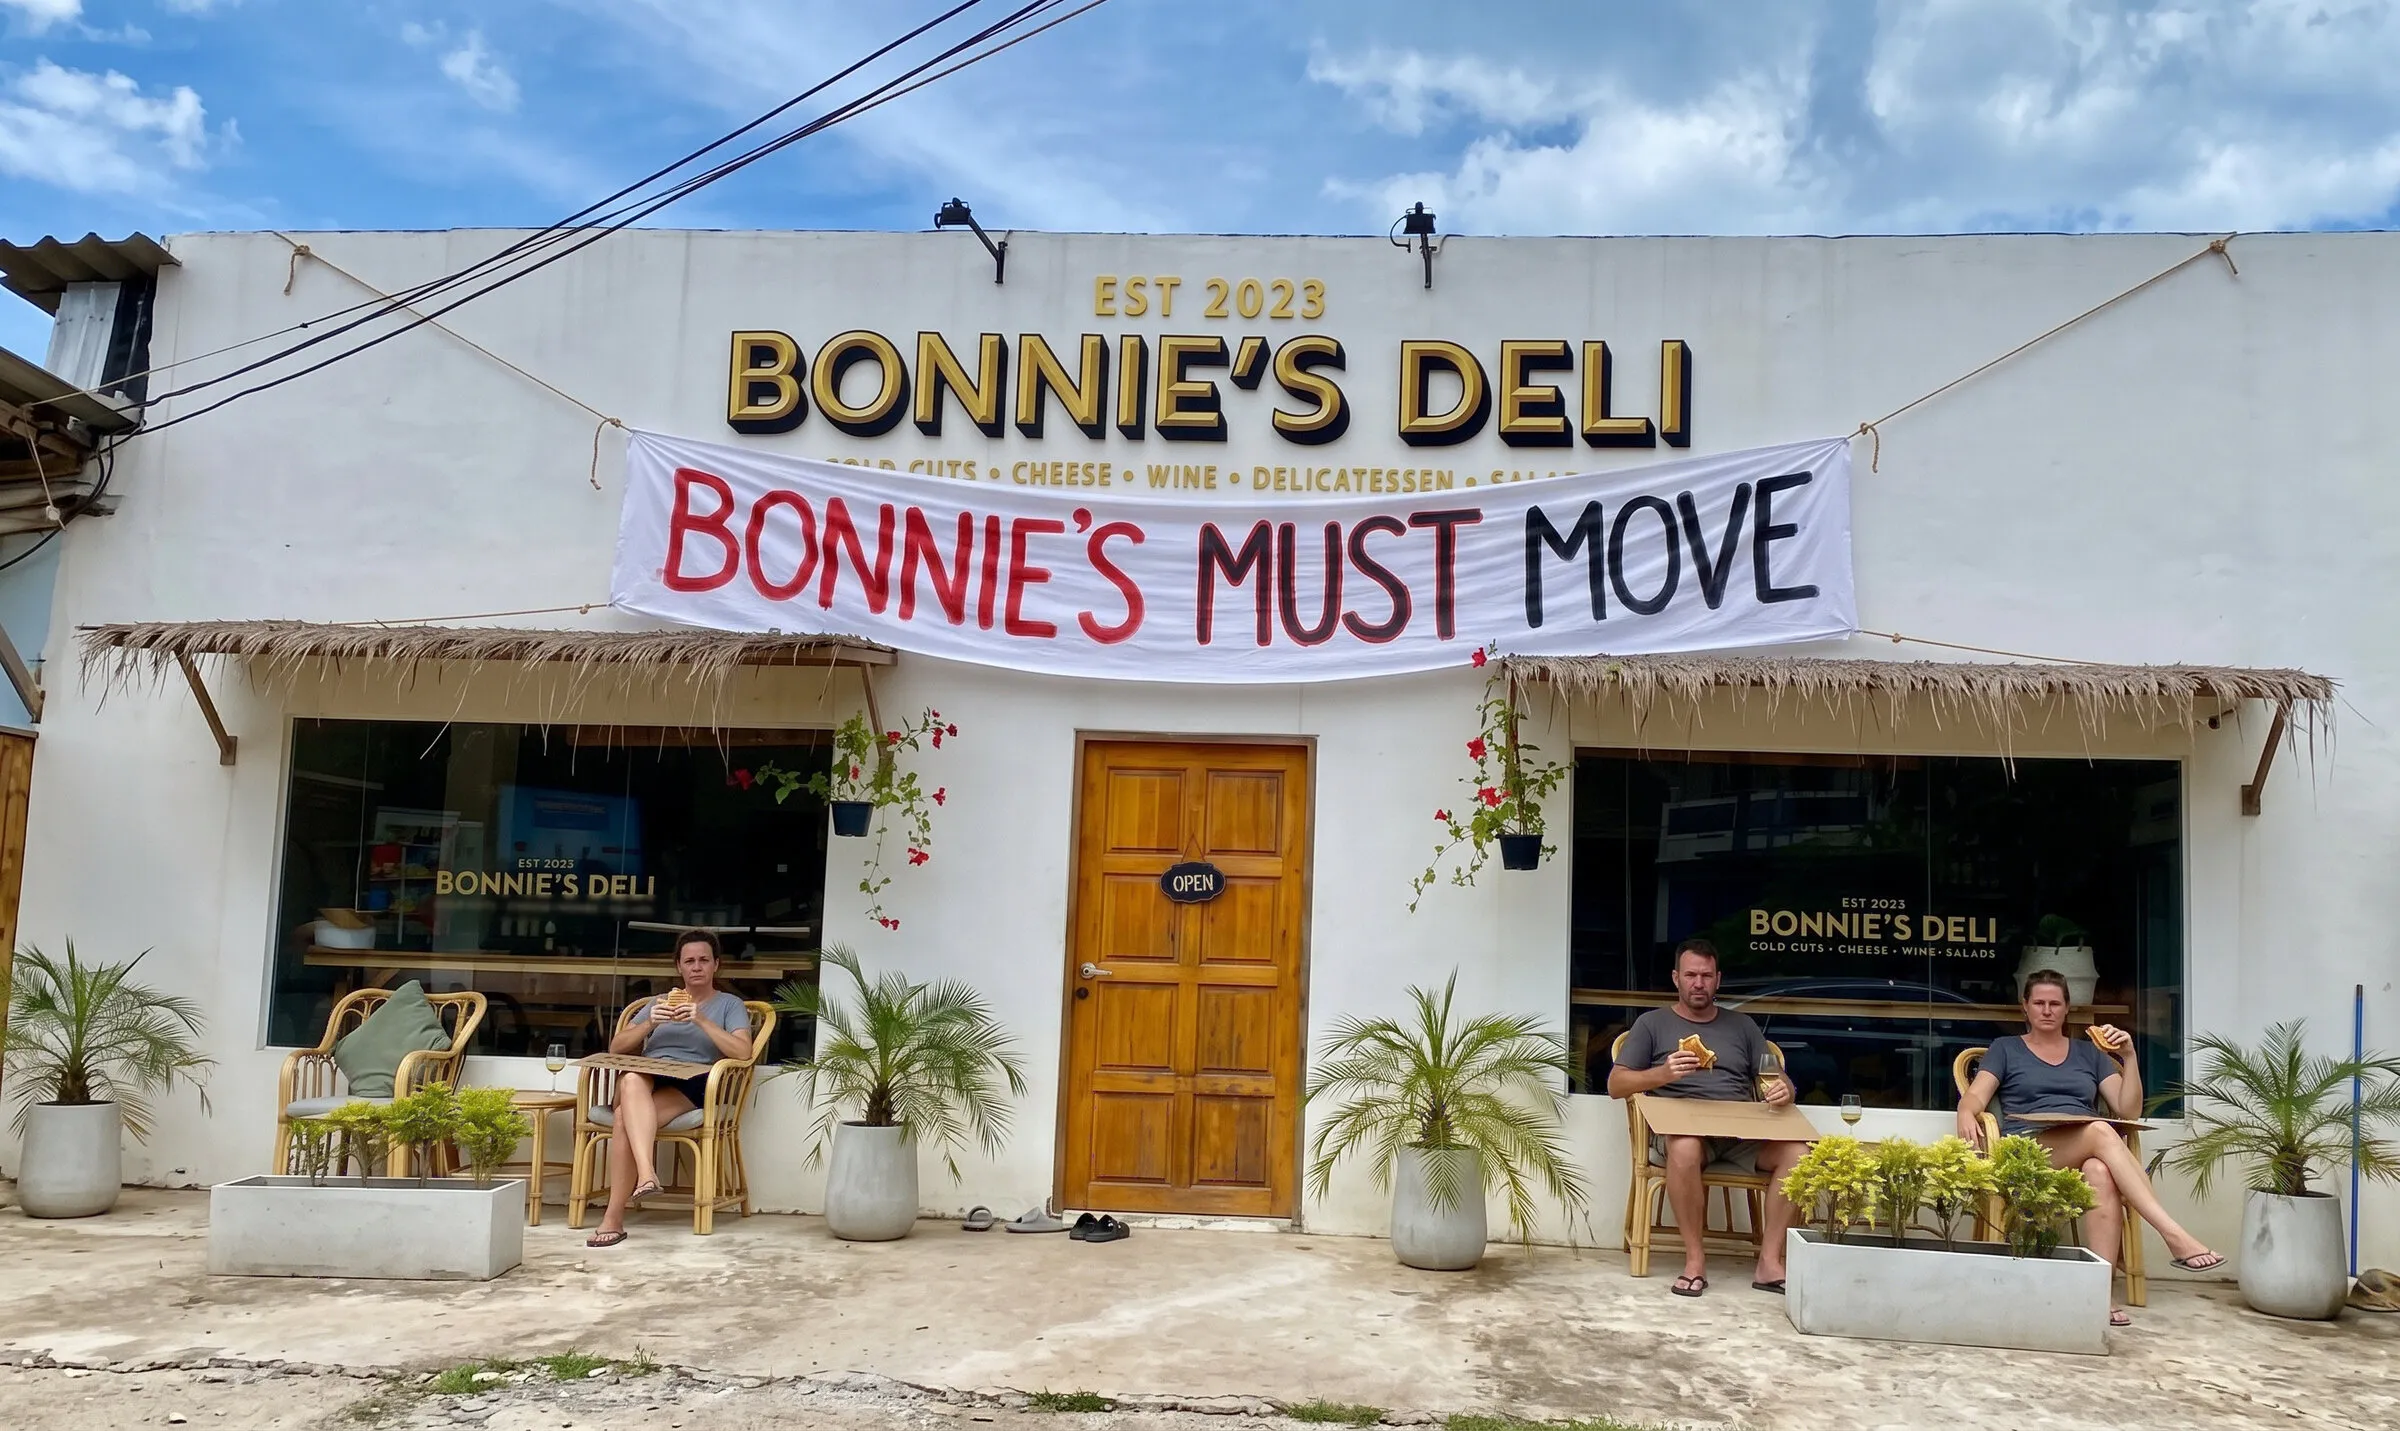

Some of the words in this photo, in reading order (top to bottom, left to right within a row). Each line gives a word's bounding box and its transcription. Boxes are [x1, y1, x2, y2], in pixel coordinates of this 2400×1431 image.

[1095, 276, 1181, 316] EST
[1204, 277, 1325, 319] 2023
[727, 330, 1350, 445] BONNIE'S
[1399, 339, 1692, 448] DELI
[1012, 461, 1111, 486] CHEESE
[1147, 464, 1217, 489] WINE
[1253, 466, 1454, 492] DELICATESSEN
[662, 467, 1146, 644] BONNIE'S
[1196, 507, 1483, 647] MUST
[1525, 471, 1820, 628] MOVE
[518, 859, 540, 868] EST
[544, 859, 575, 869] 2023
[436, 870, 579, 896] BONNIE'S
[588, 874, 655, 897] DELI
[1173, 874, 1214, 892] OPEN
[1842, 898, 1866, 908] EST
[1871, 899, 1906, 909] 2023
[1750, 909, 1912, 940] BONNIE'S
[1923, 915, 1996, 943] DELI
[1750, 941, 1786, 952] COLD
[1790, 942, 1824, 953] CUTS
[1838, 944, 1888, 955] CHEESE
[1902, 946, 1936, 957] WINE
[1945, 948, 1996, 959] SALADS
